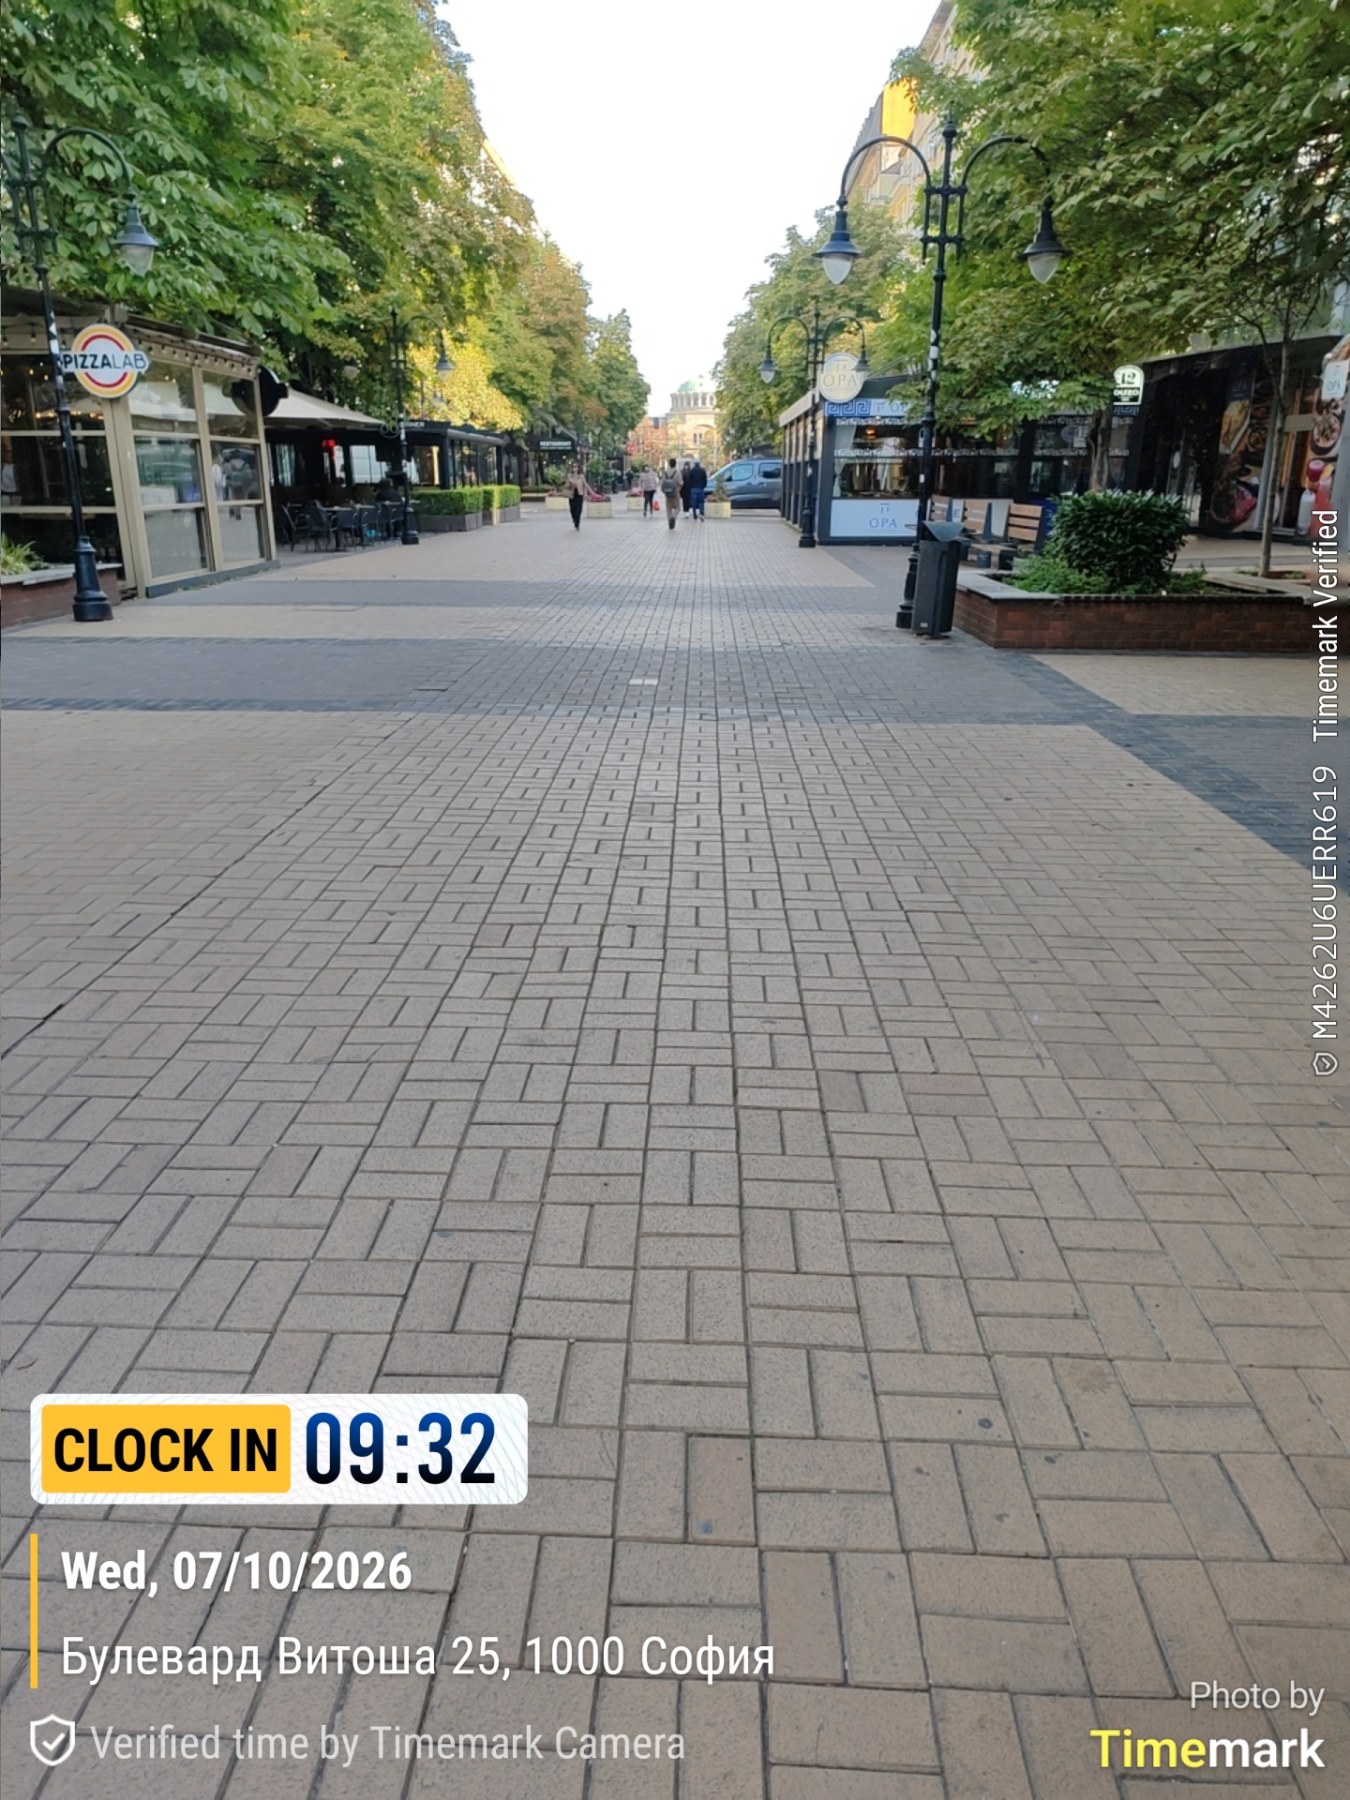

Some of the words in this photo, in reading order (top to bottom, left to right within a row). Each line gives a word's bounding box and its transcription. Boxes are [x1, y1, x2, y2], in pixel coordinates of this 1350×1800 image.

[63, 353, 146, 370] PIZZALAB
[823, 373, 857, 388] OPA
[868, 518, 898, 529] OPA
